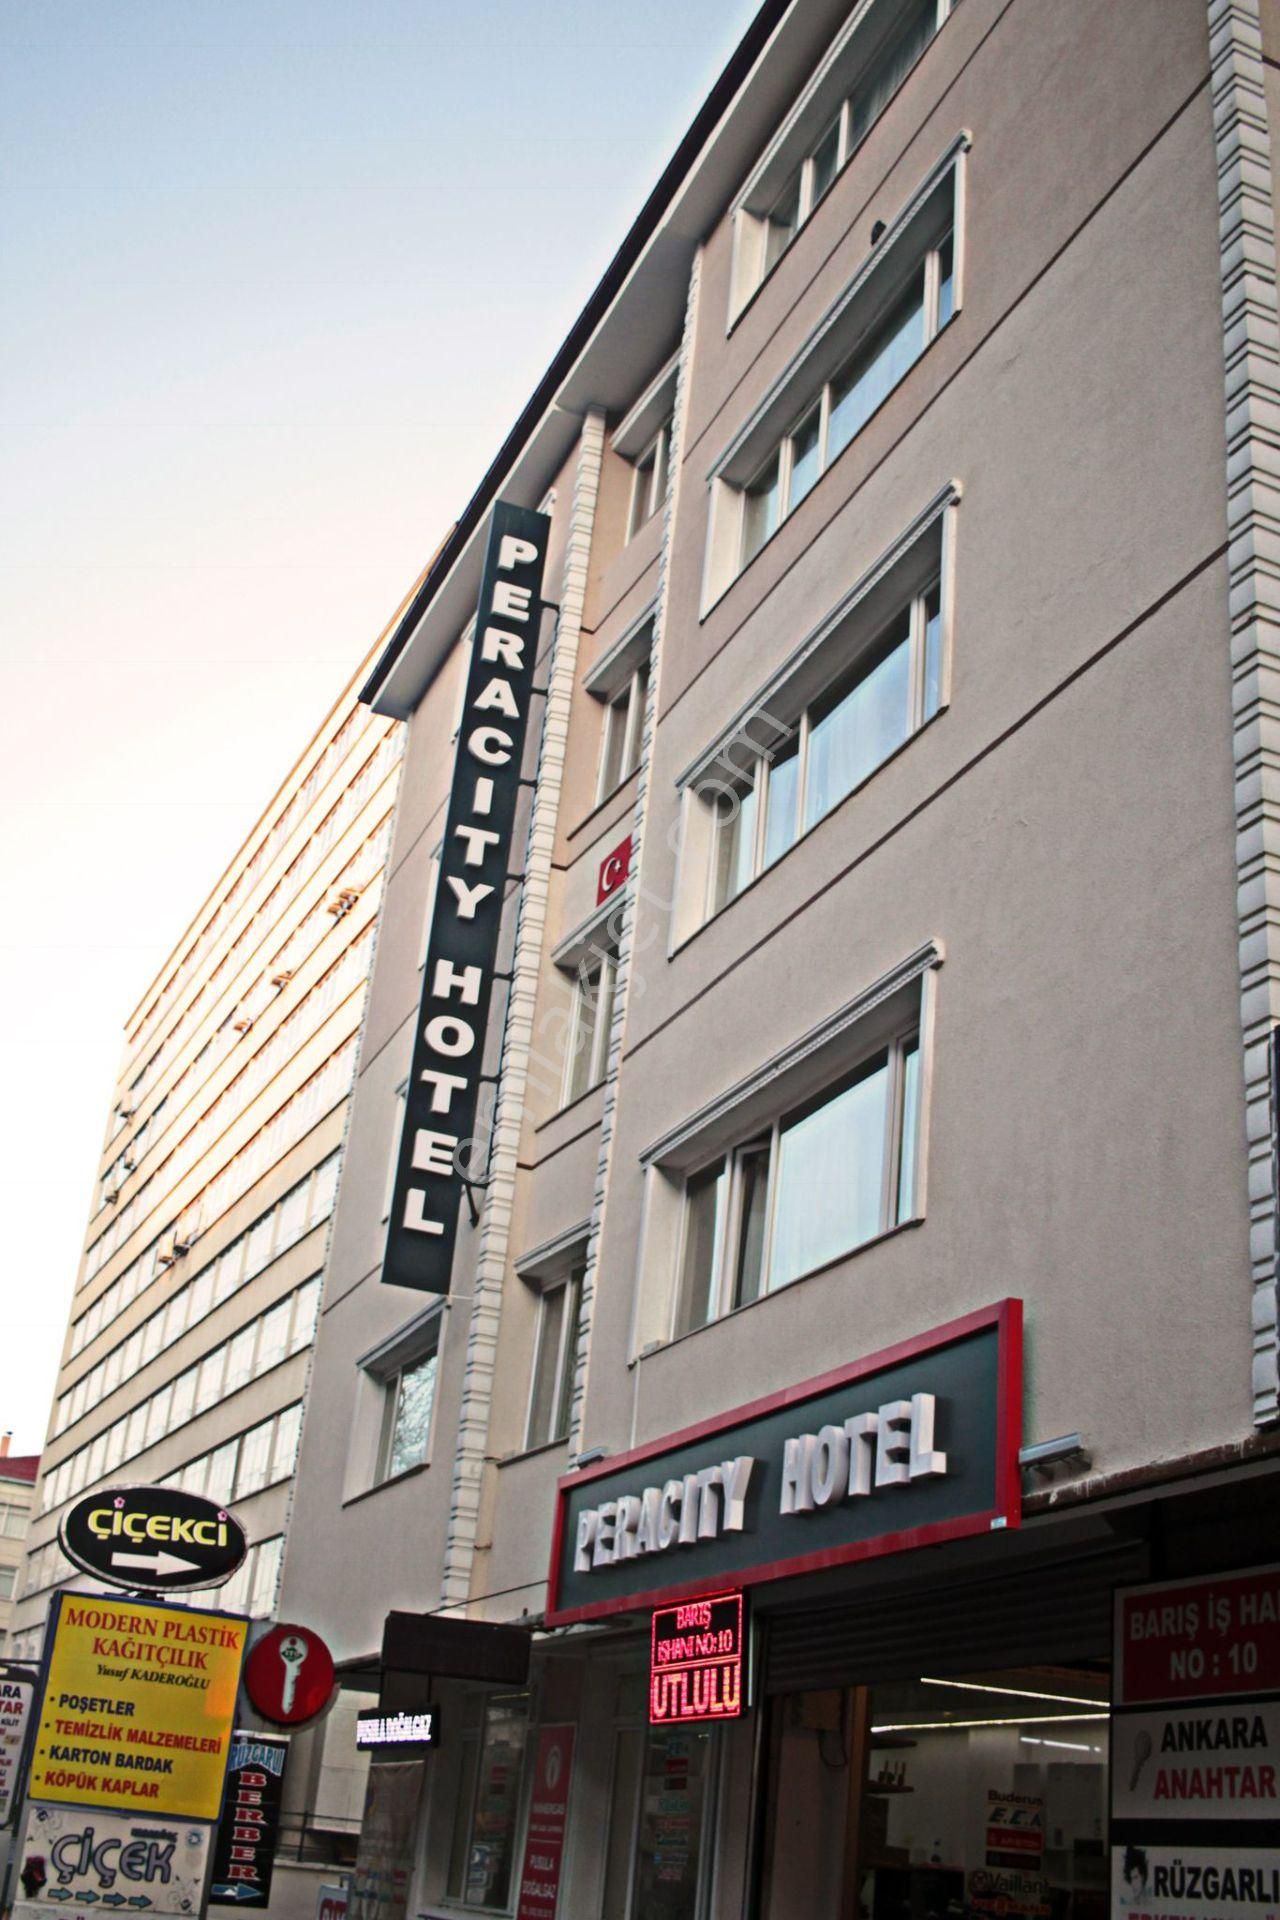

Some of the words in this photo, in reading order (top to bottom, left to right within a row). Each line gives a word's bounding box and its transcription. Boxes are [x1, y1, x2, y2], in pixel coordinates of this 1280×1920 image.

[447, 534, 538, 920] PERACITY
[402, 959, 482, 1235] HOTEL
[573, 1455, 755, 1573] PERACITY
[779, 1392, 947, 1515] HOTEL
[87, 1497, 228, 1547] ÇİÇEKCİ
[65, 1608, 159, 1637] MODERN
[162, 1620, 241, 1650] PLASTİK
[1129, 1602, 1200, 1641] BARIŞ
[1207, 1592, 1232, 1637] İŞ
[92, 1636, 210, 1670] KAĞITÇILIK
[1168, 1648, 1205, 1682] NO
[1227, 1641, 1258, 1676] 10
[97, 1663, 128, 1682] Yusuf
[130, 1668, 212, 1690] KADEROĞLU
[58, 1693, 136, 1717] POŞETLER
[55, 1718, 124, 1742] TEMİZLİK
[126, 1727, 223, 1754] MALZEMELERİ
[1160, 1715, 1269, 1753] ANKARA
[49, 1744, 111, 1768] KARTON
[115, 1753, 174, 1774] BARDAK
[44, 1768, 98, 1791] KÖPÜK
[101, 1777, 160, 1798] KAPLAR
[1153, 1764, 1277, 1801] ANAHTAR
[227, 1771, 269, 1882] BERBER
[50, 1826, 177, 1889] ÇİÇEK
[1153, 1858, 1280, 1904] RÜZGARLI
